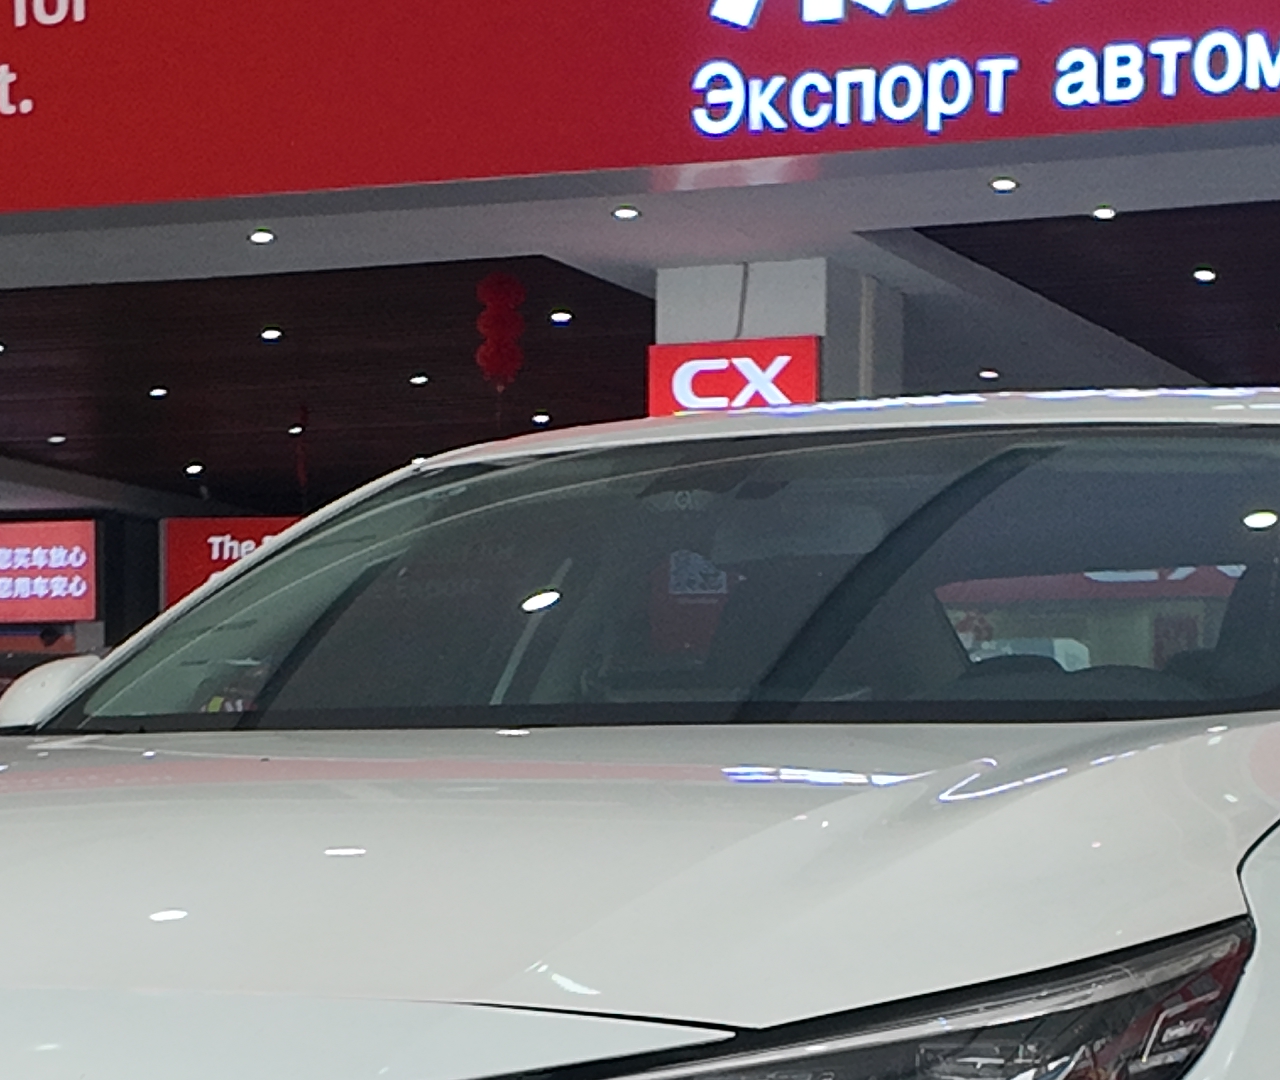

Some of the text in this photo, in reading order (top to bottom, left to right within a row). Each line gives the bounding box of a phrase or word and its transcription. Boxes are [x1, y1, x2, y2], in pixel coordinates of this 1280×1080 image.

[691, 56, 1019, 136] Экспорт
[671, 355, 792, 409] CX
[207, 534, 258, 560] The
